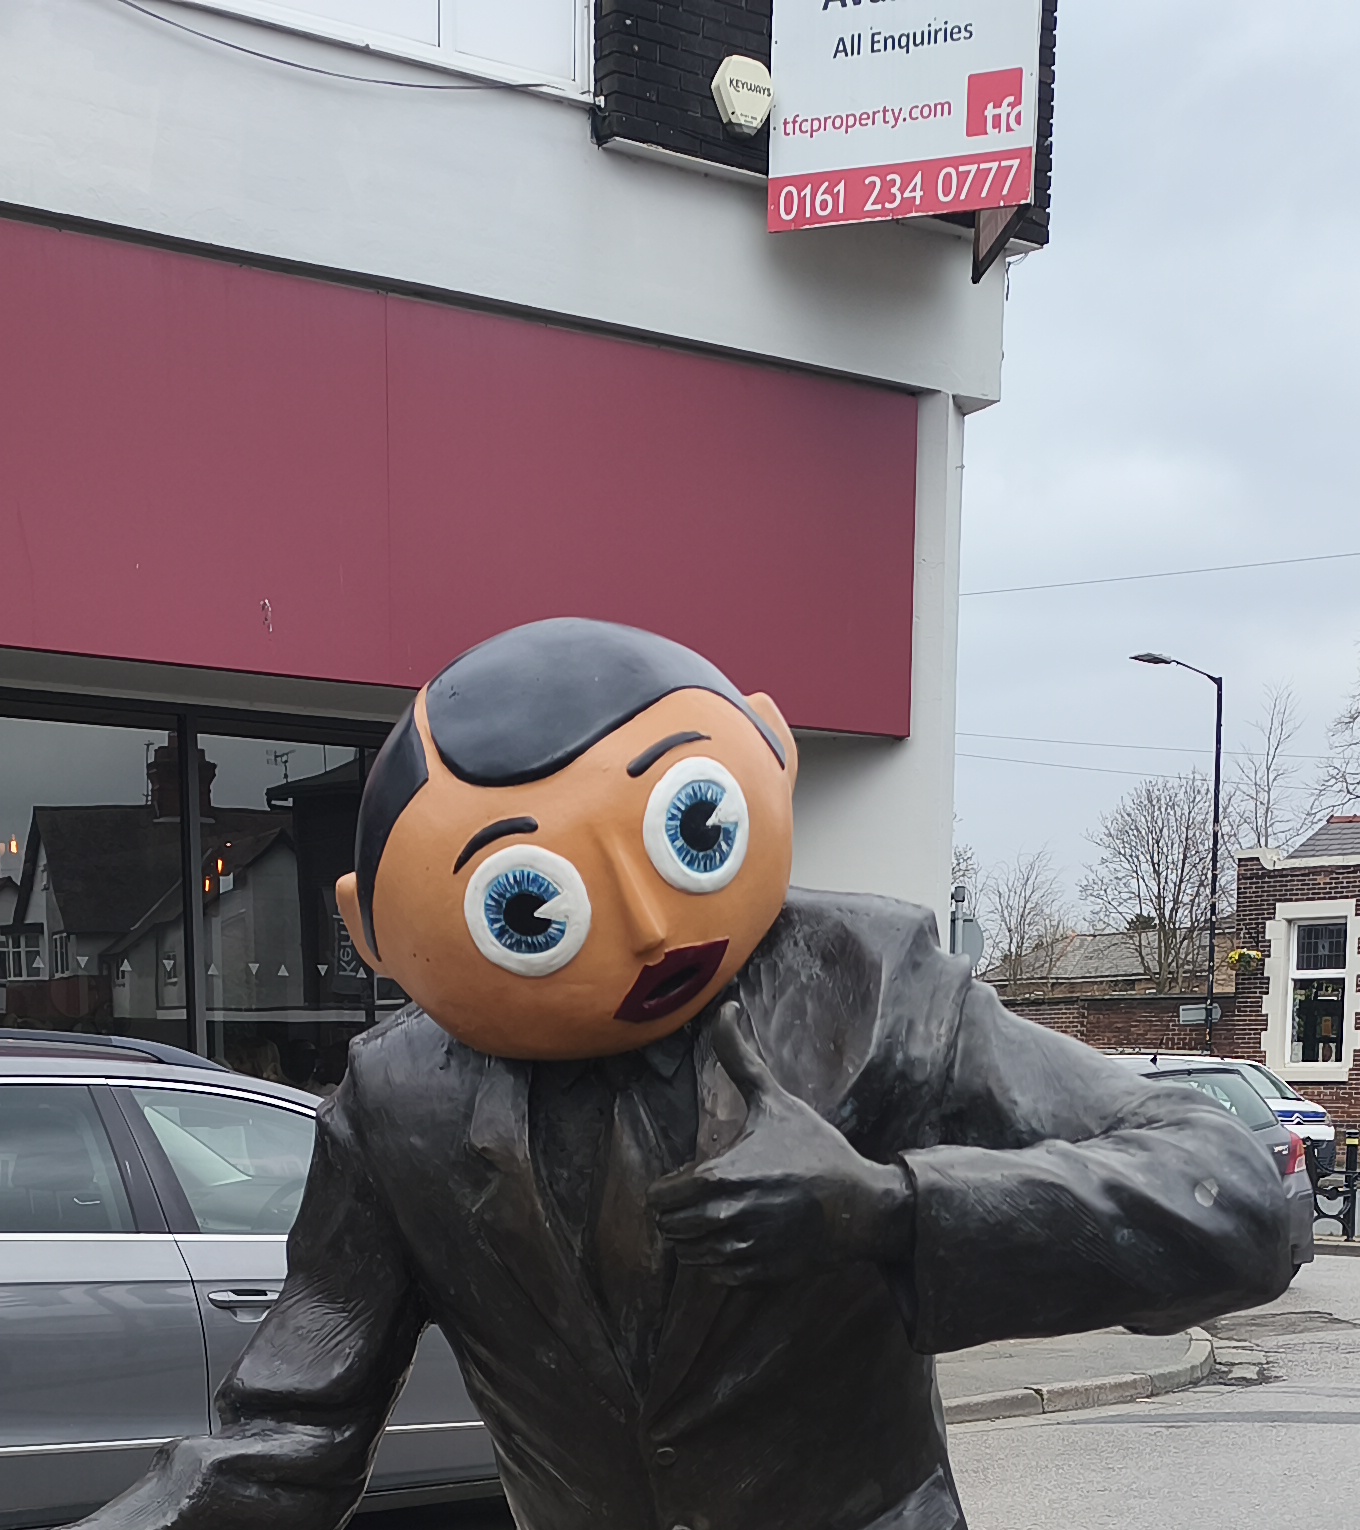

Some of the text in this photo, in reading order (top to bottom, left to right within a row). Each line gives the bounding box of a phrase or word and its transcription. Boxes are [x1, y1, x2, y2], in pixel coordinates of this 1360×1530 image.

[833, 21, 973, 59] All Enquiries
[729, 77, 772, 97] KEYWAYS
[782, 100, 952, 138] tfcproperty.com
[984, 96, 1022, 134] tfc
[779, 159, 1021, 221] 0161 234 0777
